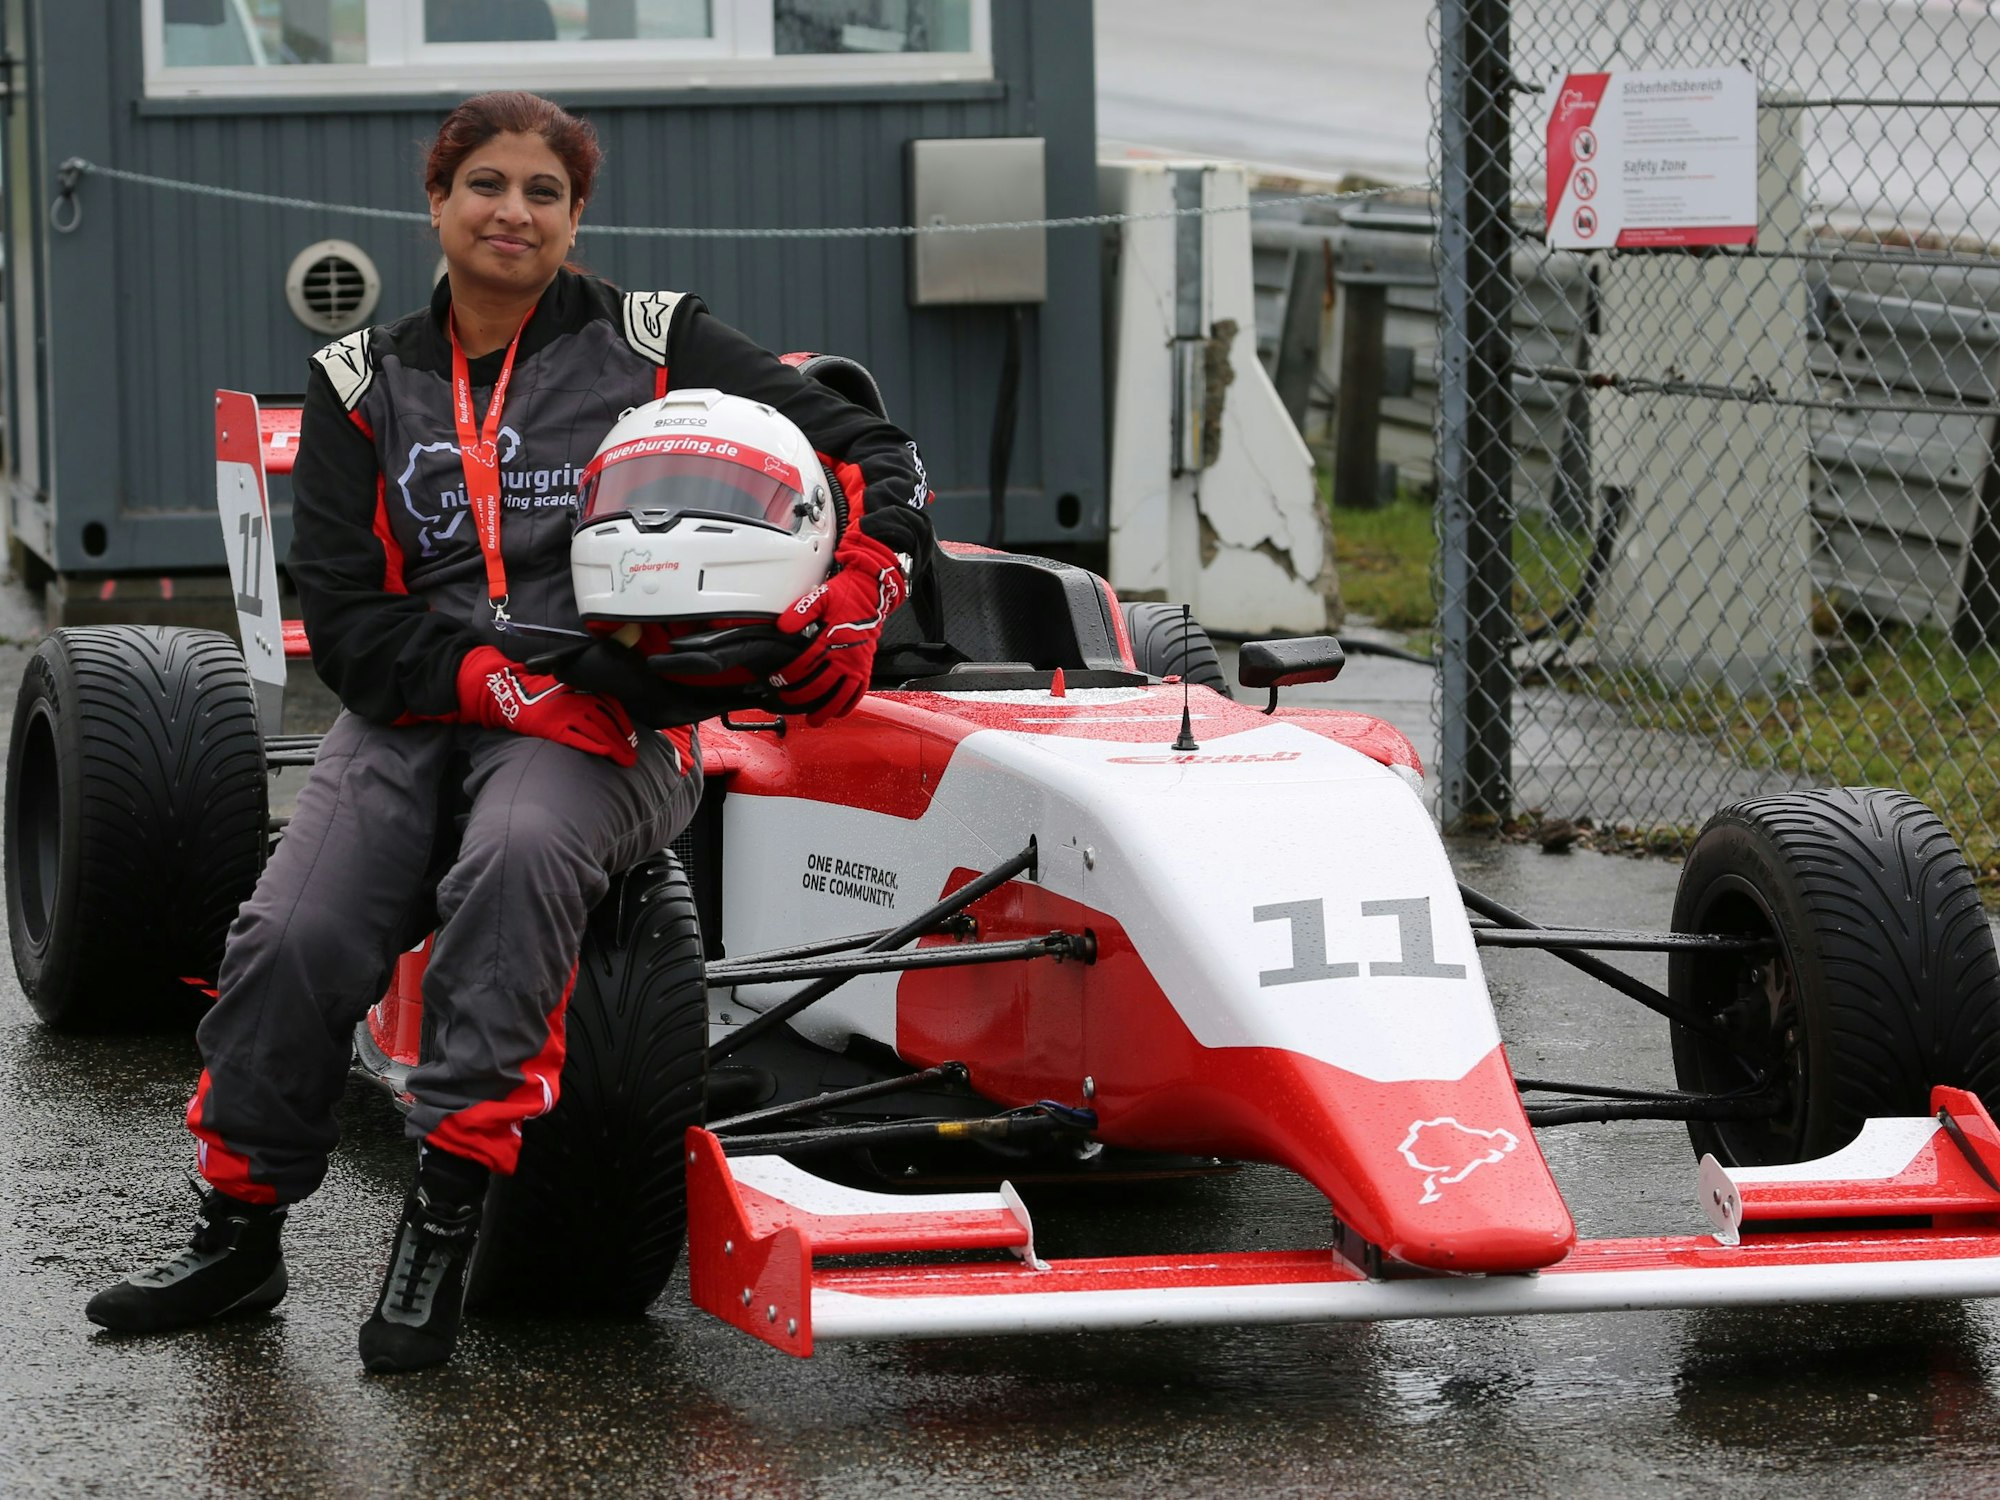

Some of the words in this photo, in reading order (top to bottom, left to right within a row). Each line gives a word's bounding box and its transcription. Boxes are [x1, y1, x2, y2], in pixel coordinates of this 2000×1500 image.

[1623, 79, 1723, 95] Sicherheitsbereich
[1623, 160, 1657, 174] Safety
[1660, 159, 1687, 172] Zone
[604, 438, 738, 464] nuerburgring.de
[533, 492, 578, 508] acade
[486, 494, 497, 550] nürburgring
[237, 512, 263, 618] 11
[629, 560, 679, 573] nürburgring
[807, 854, 833, 873] ONE
[802, 873, 826, 892] ONE
[1253, 896, 1467, 988] 11
